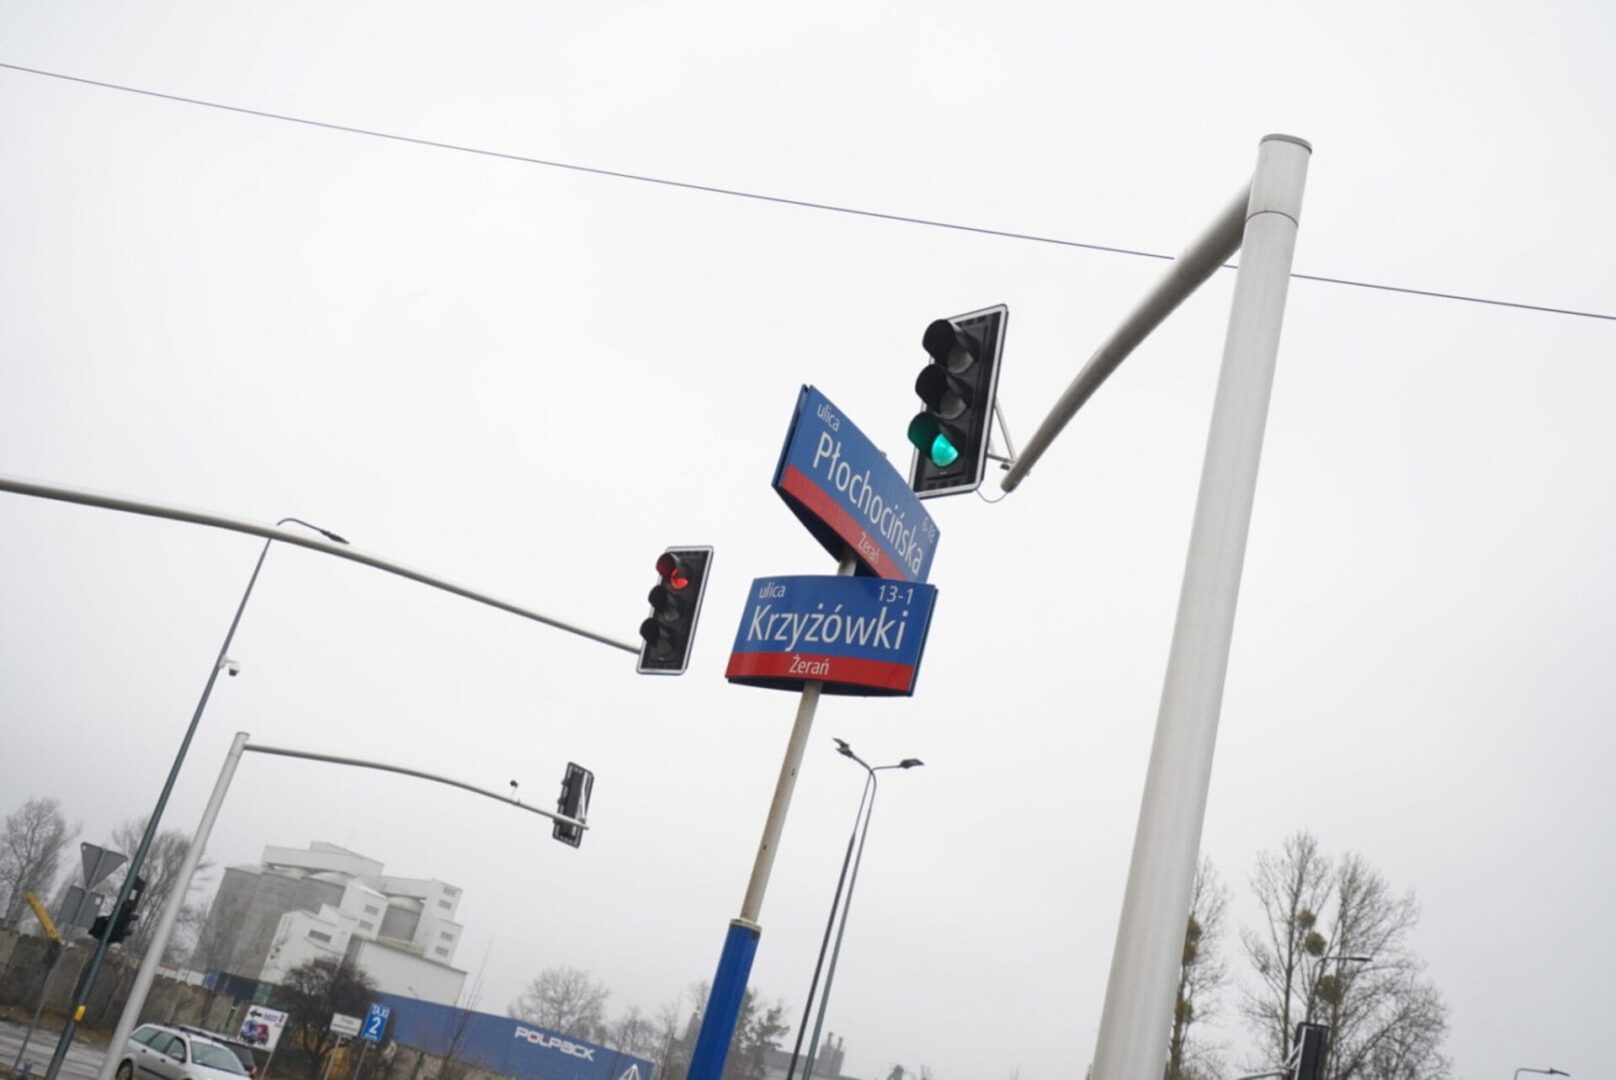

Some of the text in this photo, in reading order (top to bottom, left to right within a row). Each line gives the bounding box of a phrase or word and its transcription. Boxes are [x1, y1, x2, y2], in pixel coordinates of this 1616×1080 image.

[817, 402, 840, 431] ulica
[812, 431, 923, 576] Płochocińska
[857, 531, 880, 562] Żerań
[758, 583, 786, 599] ulica
[878, 585, 914, 604] 13-1
[746, 602, 909, 652] Krzyżówki
[788, 655, 830, 675] Żerań
[368, 1016, 381, 1034] 2
